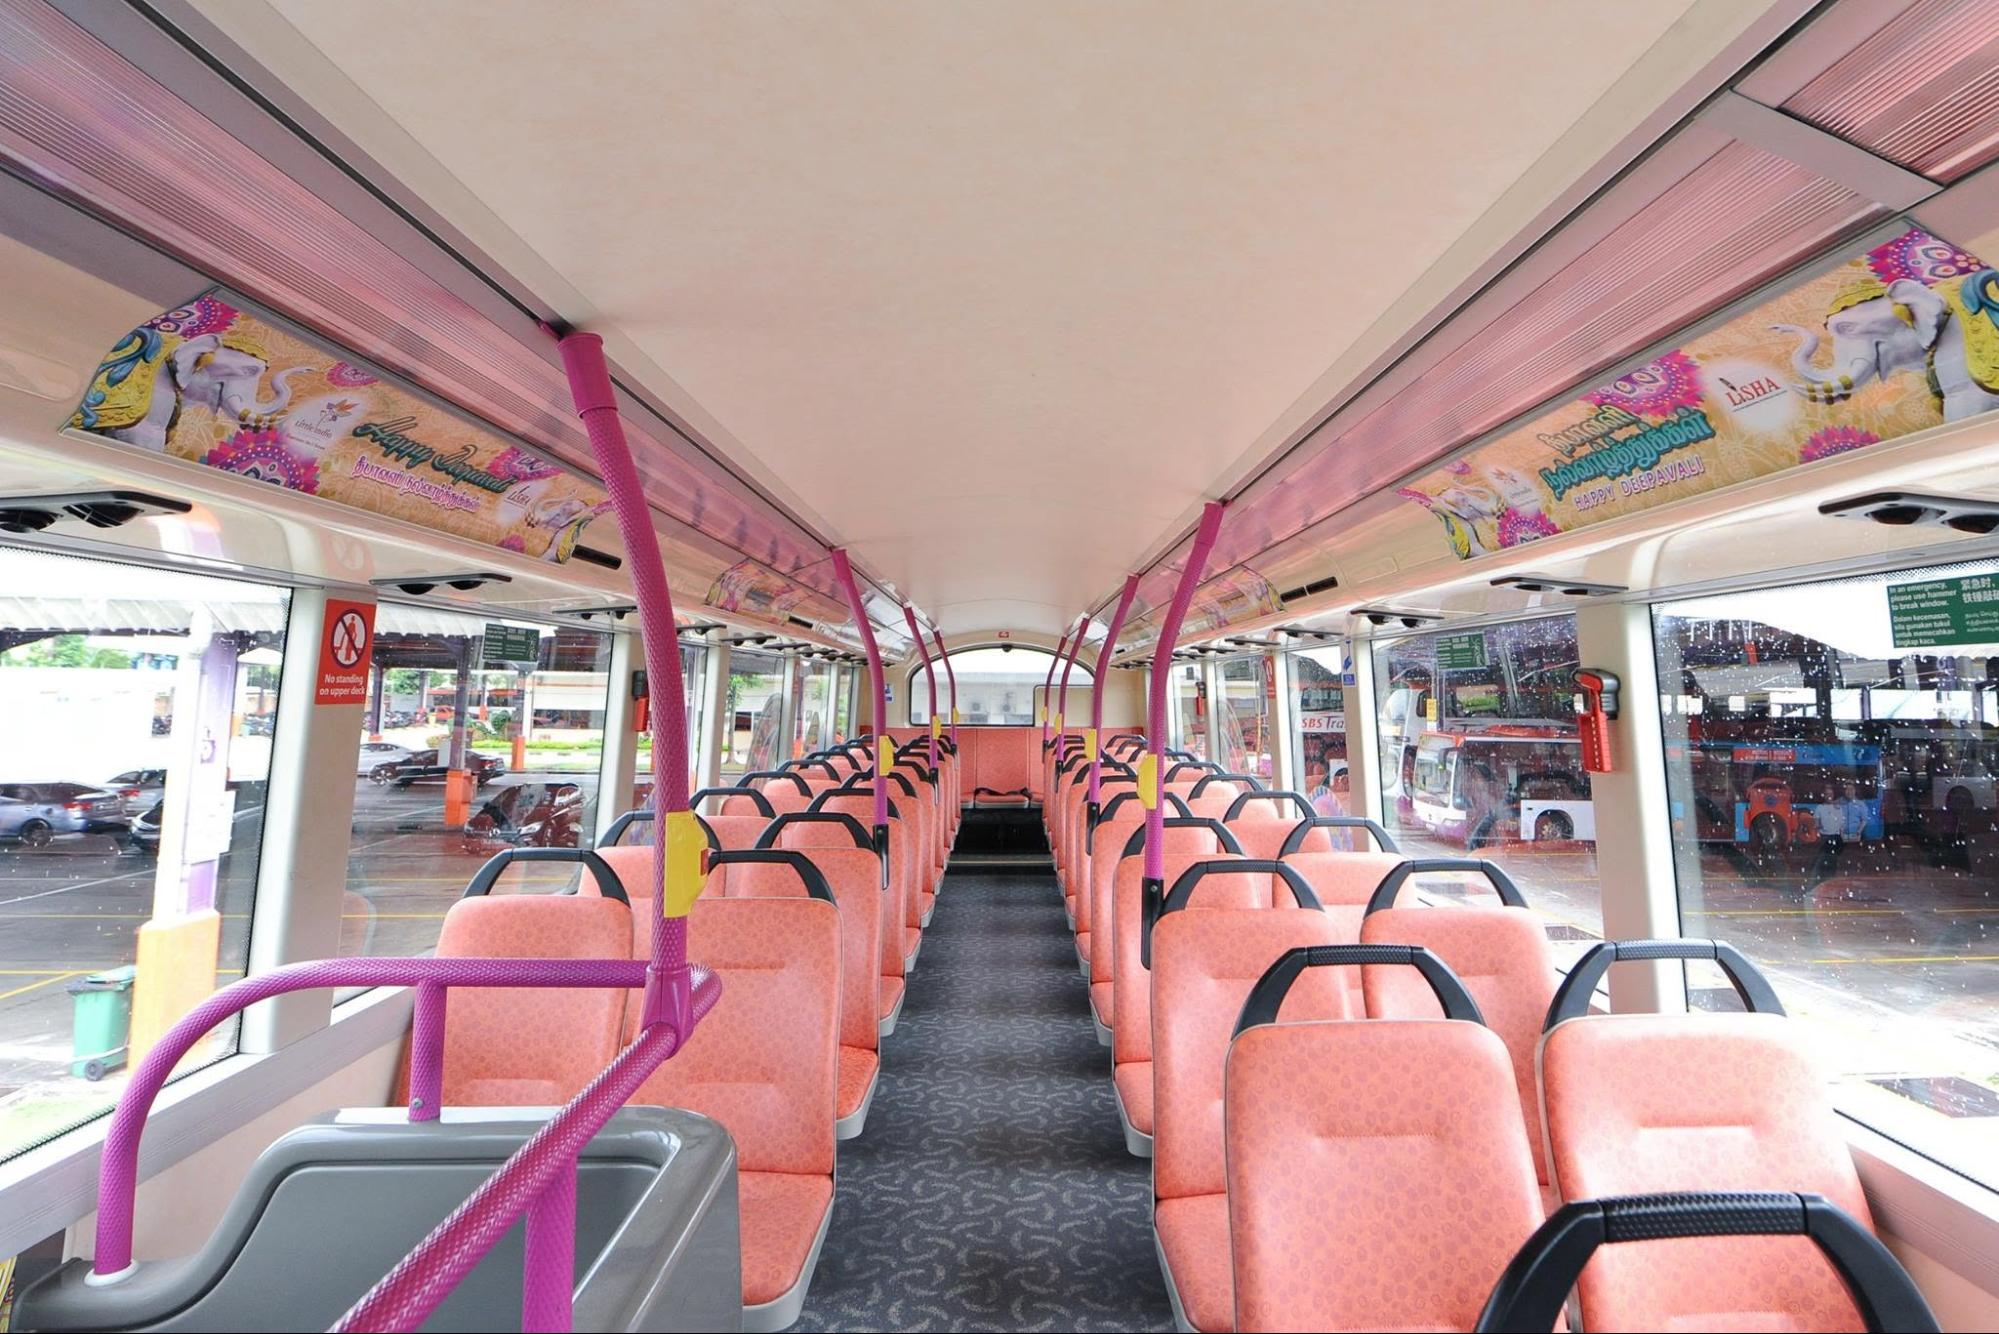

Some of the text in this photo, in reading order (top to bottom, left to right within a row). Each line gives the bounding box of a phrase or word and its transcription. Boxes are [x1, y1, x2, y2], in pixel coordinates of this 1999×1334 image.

[1726, 377, 1781, 406] LISHA
[352, 416, 435, 469] Happy
[1573, 455, 1706, 511] HAPPY DEEPAVALI
[1927, 590, 1957, 598] hammer
[1899, 601, 1919, 610] break
[1919, 600, 1949, 608] window.
[324, 674, 363, 685] No standing
[330, 687, 350, 697] upper
[351, 687, 365, 695] deck
[1302, 716, 1344, 730] SBS Tra
